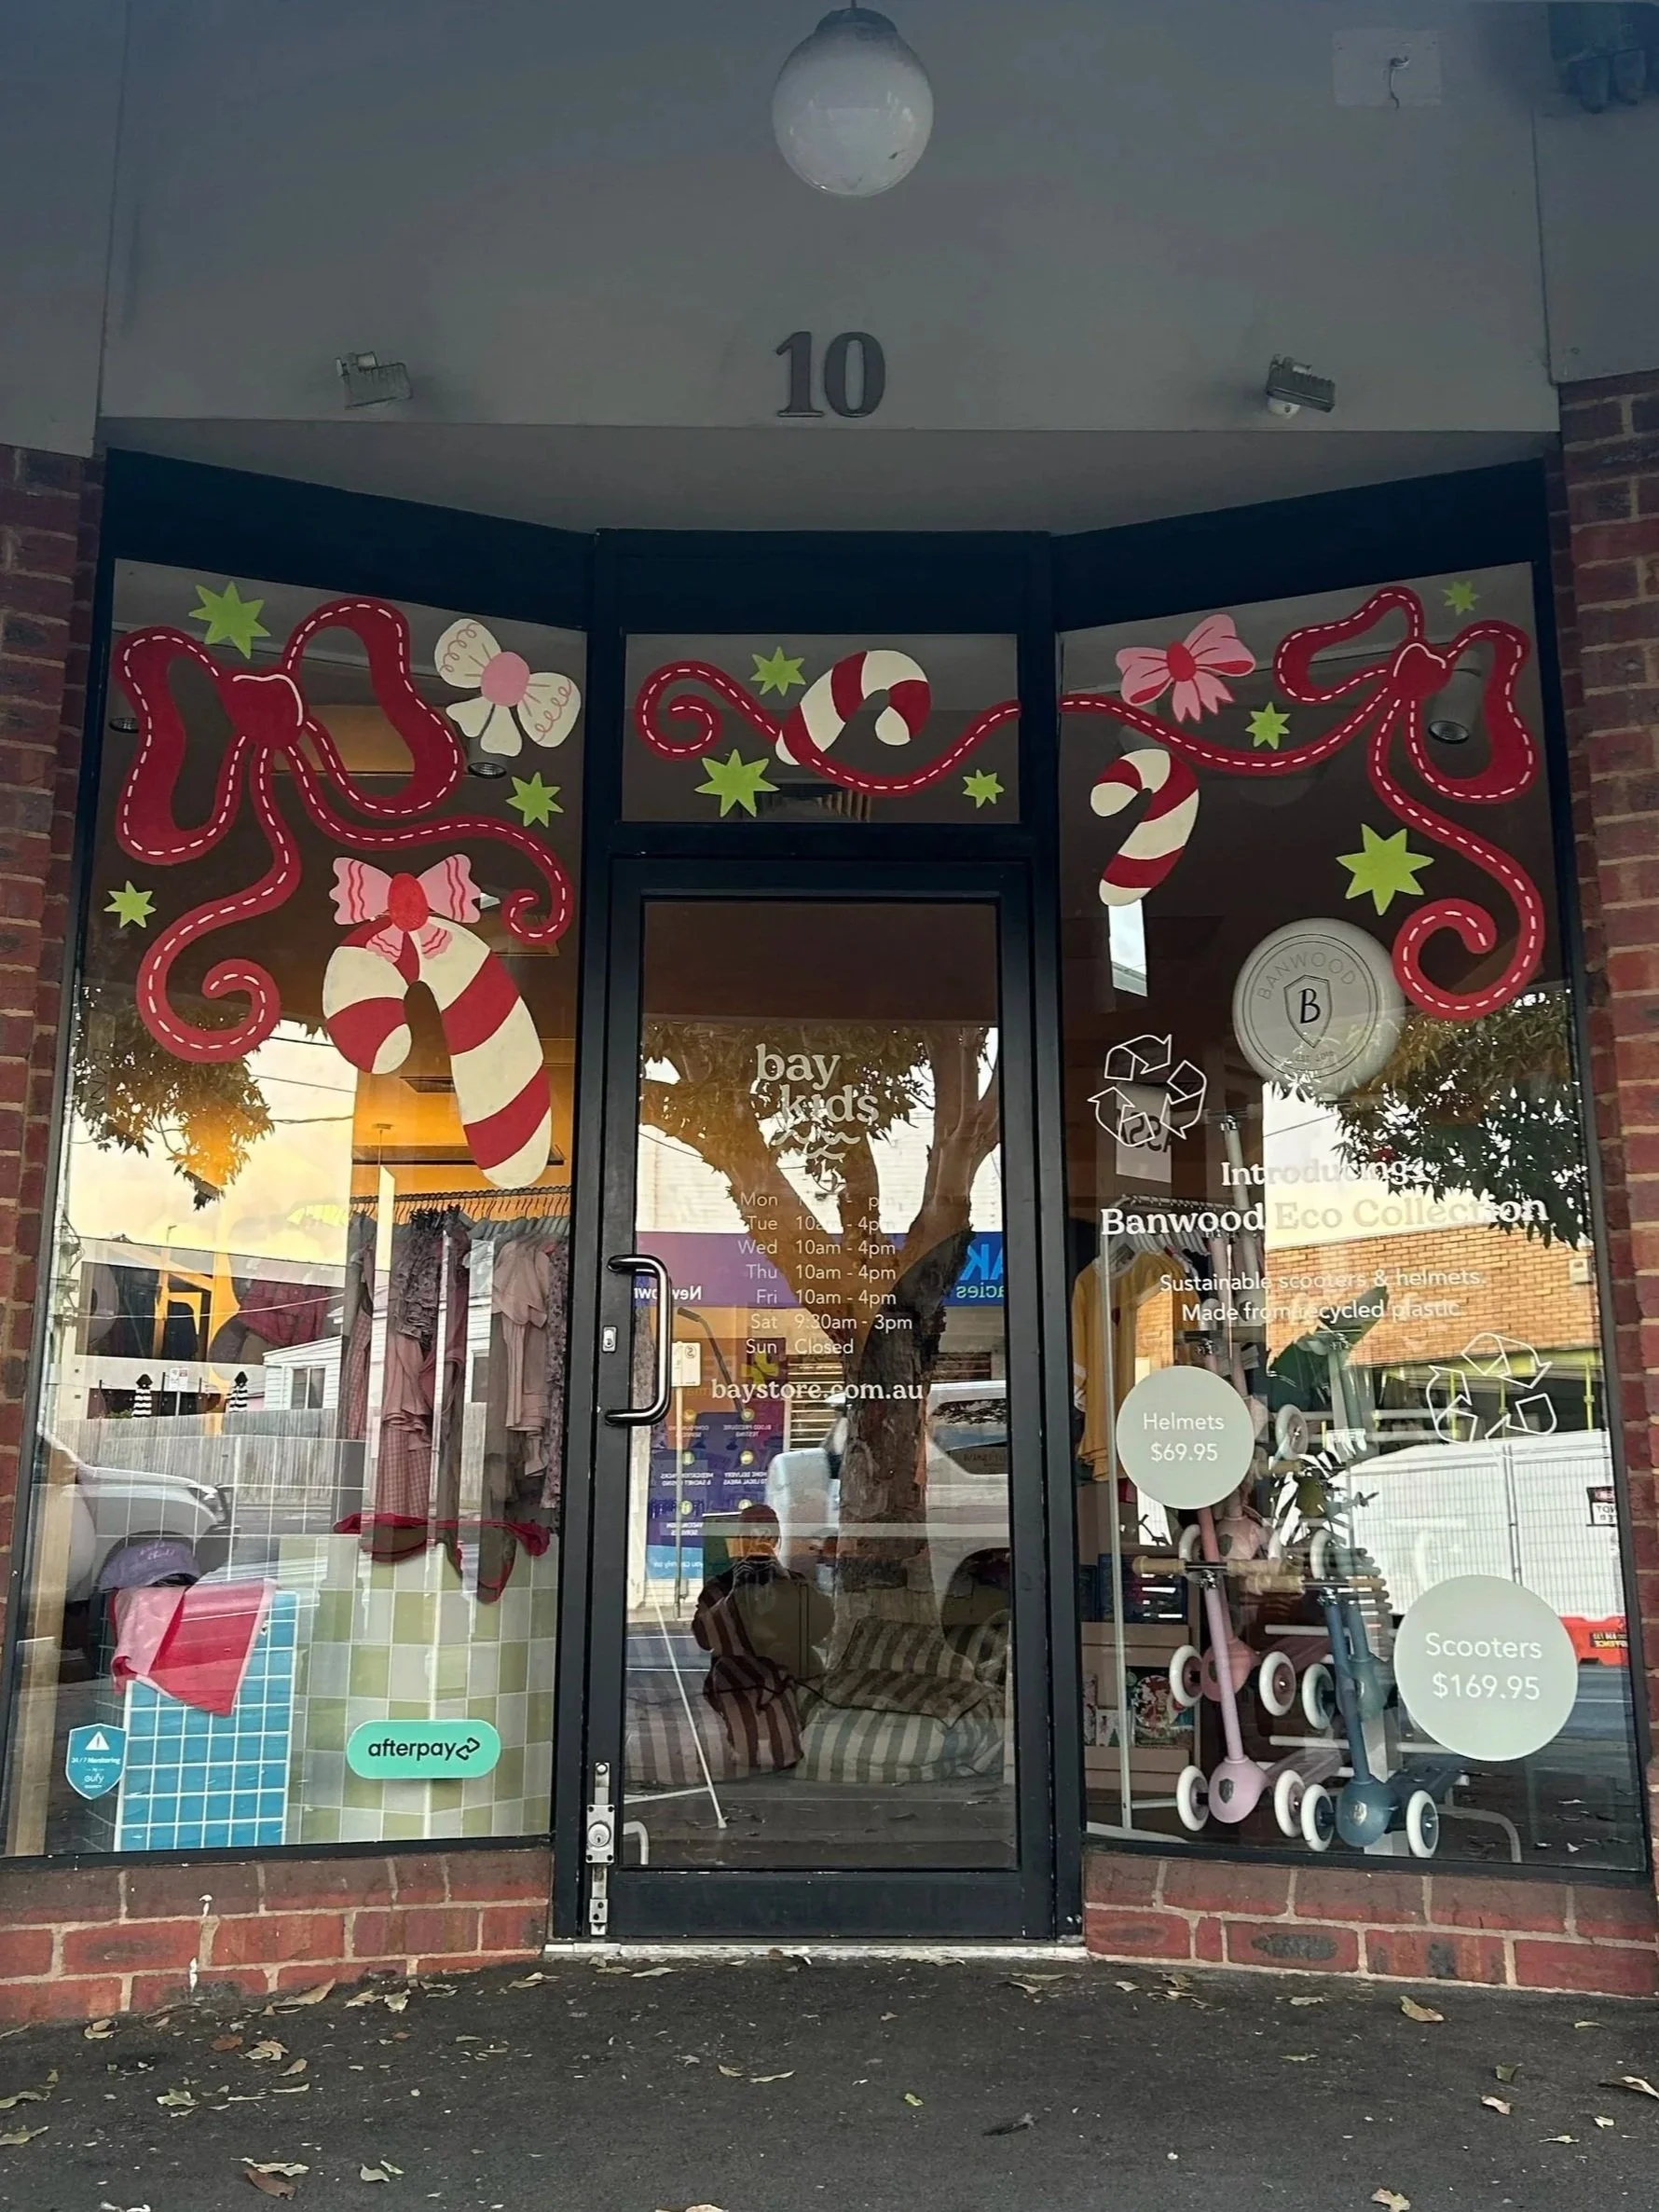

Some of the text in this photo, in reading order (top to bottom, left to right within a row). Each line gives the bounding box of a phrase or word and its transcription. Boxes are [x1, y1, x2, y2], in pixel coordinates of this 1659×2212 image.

[775, 331, 885, 418] 10
[1258, 951, 1357, 1000] BANWOOD
[1298, 987, 1321, 1024] B
[756, 1043, 842, 1091] bay
[779, 1084, 880, 1123] kids
[1221, 1158, 1407, 1186] Introducing
[740, 1191, 778, 1206] Mon
[747, 1215, 778, 1230] Tue
[1101, 1194, 1550, 1236] Banwood Eco Collection
[737, 1239, 778, 1255] Wed
[796, 1240, 841, 1255] 10am
[857, 1240, 896, 1258] 4pm
[747, 1263, 778, 1279] Thu
[796, 1264, 841, 1280] 10am
[857, 1264, 897, 1284] 4pm
[1159, 1271, 1272, 1292] Sustainable
[1279, 1272, 1366, 1289] scooters
[1373, 1269, 1389, 1287] &
[756, 1288, 778, 1304] Fri
[796, 1289, 841, 1304] 10am
[857, 1289, 897, 1308] 4pm
[1182, 1302, 1239, 1322] Made
[1243, 1301, 1292, 1320] from
[1296, 1299, 1384, 1324] recycled
[750, 1313, 778, 1329] Sat
[794, 1313, 857, 1329] 9:30am
[874, 1314, 912, 1334] 3pm
[746, 1339, 855, 1354] Sun Closed
[711, 1379, 924, 1403] baystore.com.au
[1143, 1411, 1226, 1431] Helmets
[1150, 1441, 1218, 1463] $69.95
[1425, 1631, 1542, 1659] Scooters
[1433, 1671, 1541, 1701] $169.95
[368, 1738, 457, 1761] afterpay
